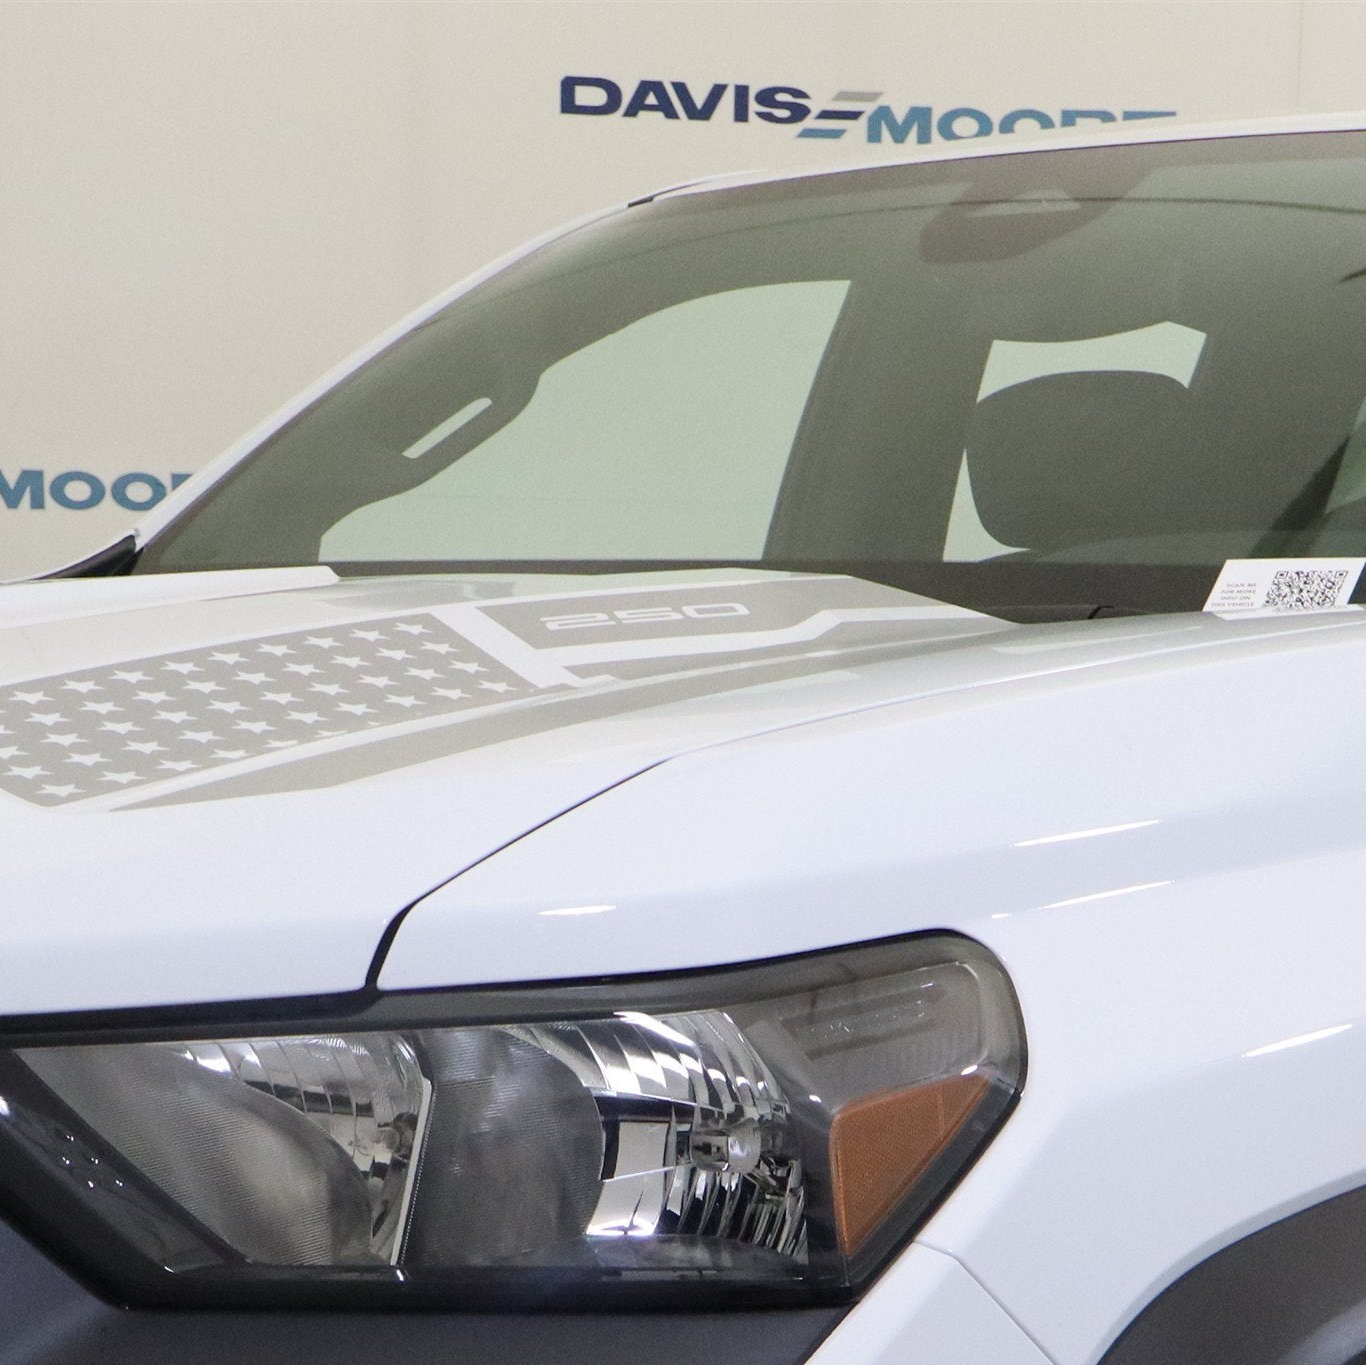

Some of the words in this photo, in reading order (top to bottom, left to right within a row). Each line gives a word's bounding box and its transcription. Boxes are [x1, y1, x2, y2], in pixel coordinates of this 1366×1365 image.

[559, 76, 812, 124] DAVIS
[866, 105, 1177, 144] MOO
[539, 602, 751, 631] 250
